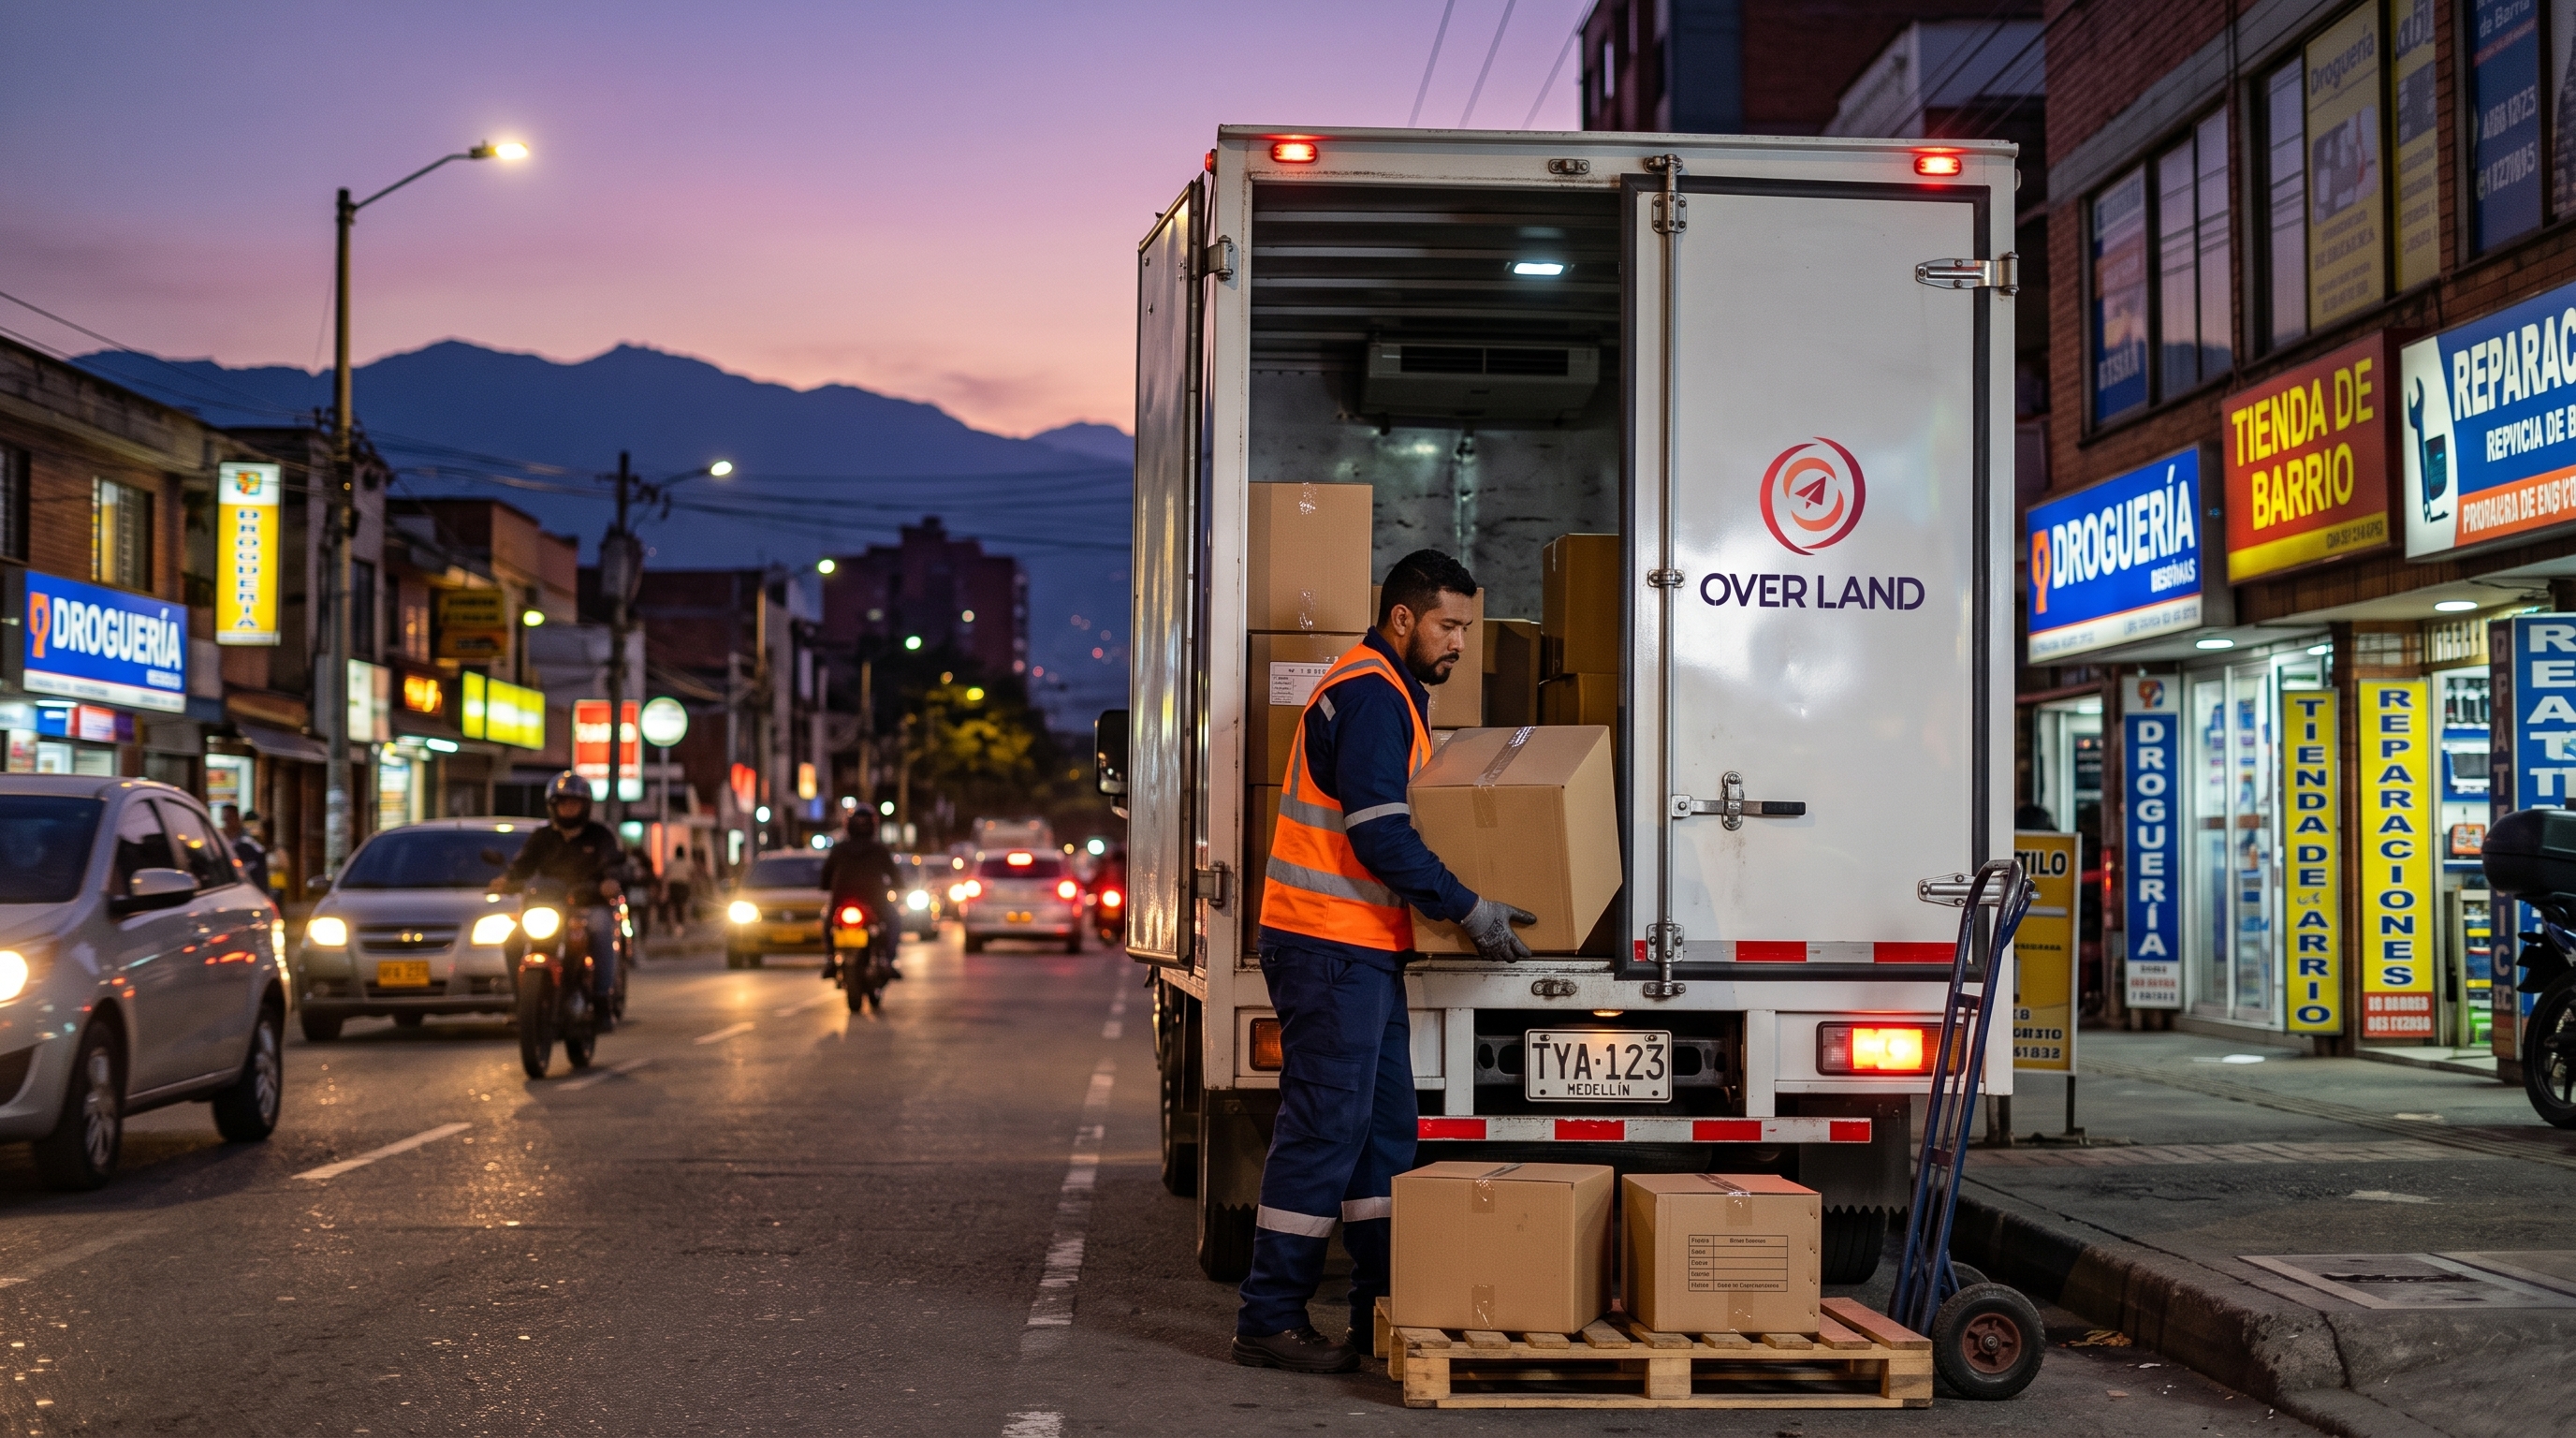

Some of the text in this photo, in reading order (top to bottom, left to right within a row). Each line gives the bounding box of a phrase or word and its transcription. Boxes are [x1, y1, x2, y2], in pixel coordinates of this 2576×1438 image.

[2310, 23, 2375, 95] Droguería
[2452, 307, 2576, 421] REPARAC
[2232, 357, 2374, 467] TIENDA DE
[2546, 407, 2565, 446] DE
[2052, 464, 2195, 589] DROGUERÍA
[2251, 442, 2355, 531] BARRIO
[52, 597, 183, 671] DROGUERÍA
[1699, 572, 1925, 610] OVER LAND
[2295, 698, 2329, 834] TIENDA
[2136, 719, 2168, 957] DROGUERÍA
[2296, 844, 2329, 887] DE
[2378, 688, 2415, 986] REPARACIONES
[1567, 1081, 1631, 1096] MEDELLÍN
